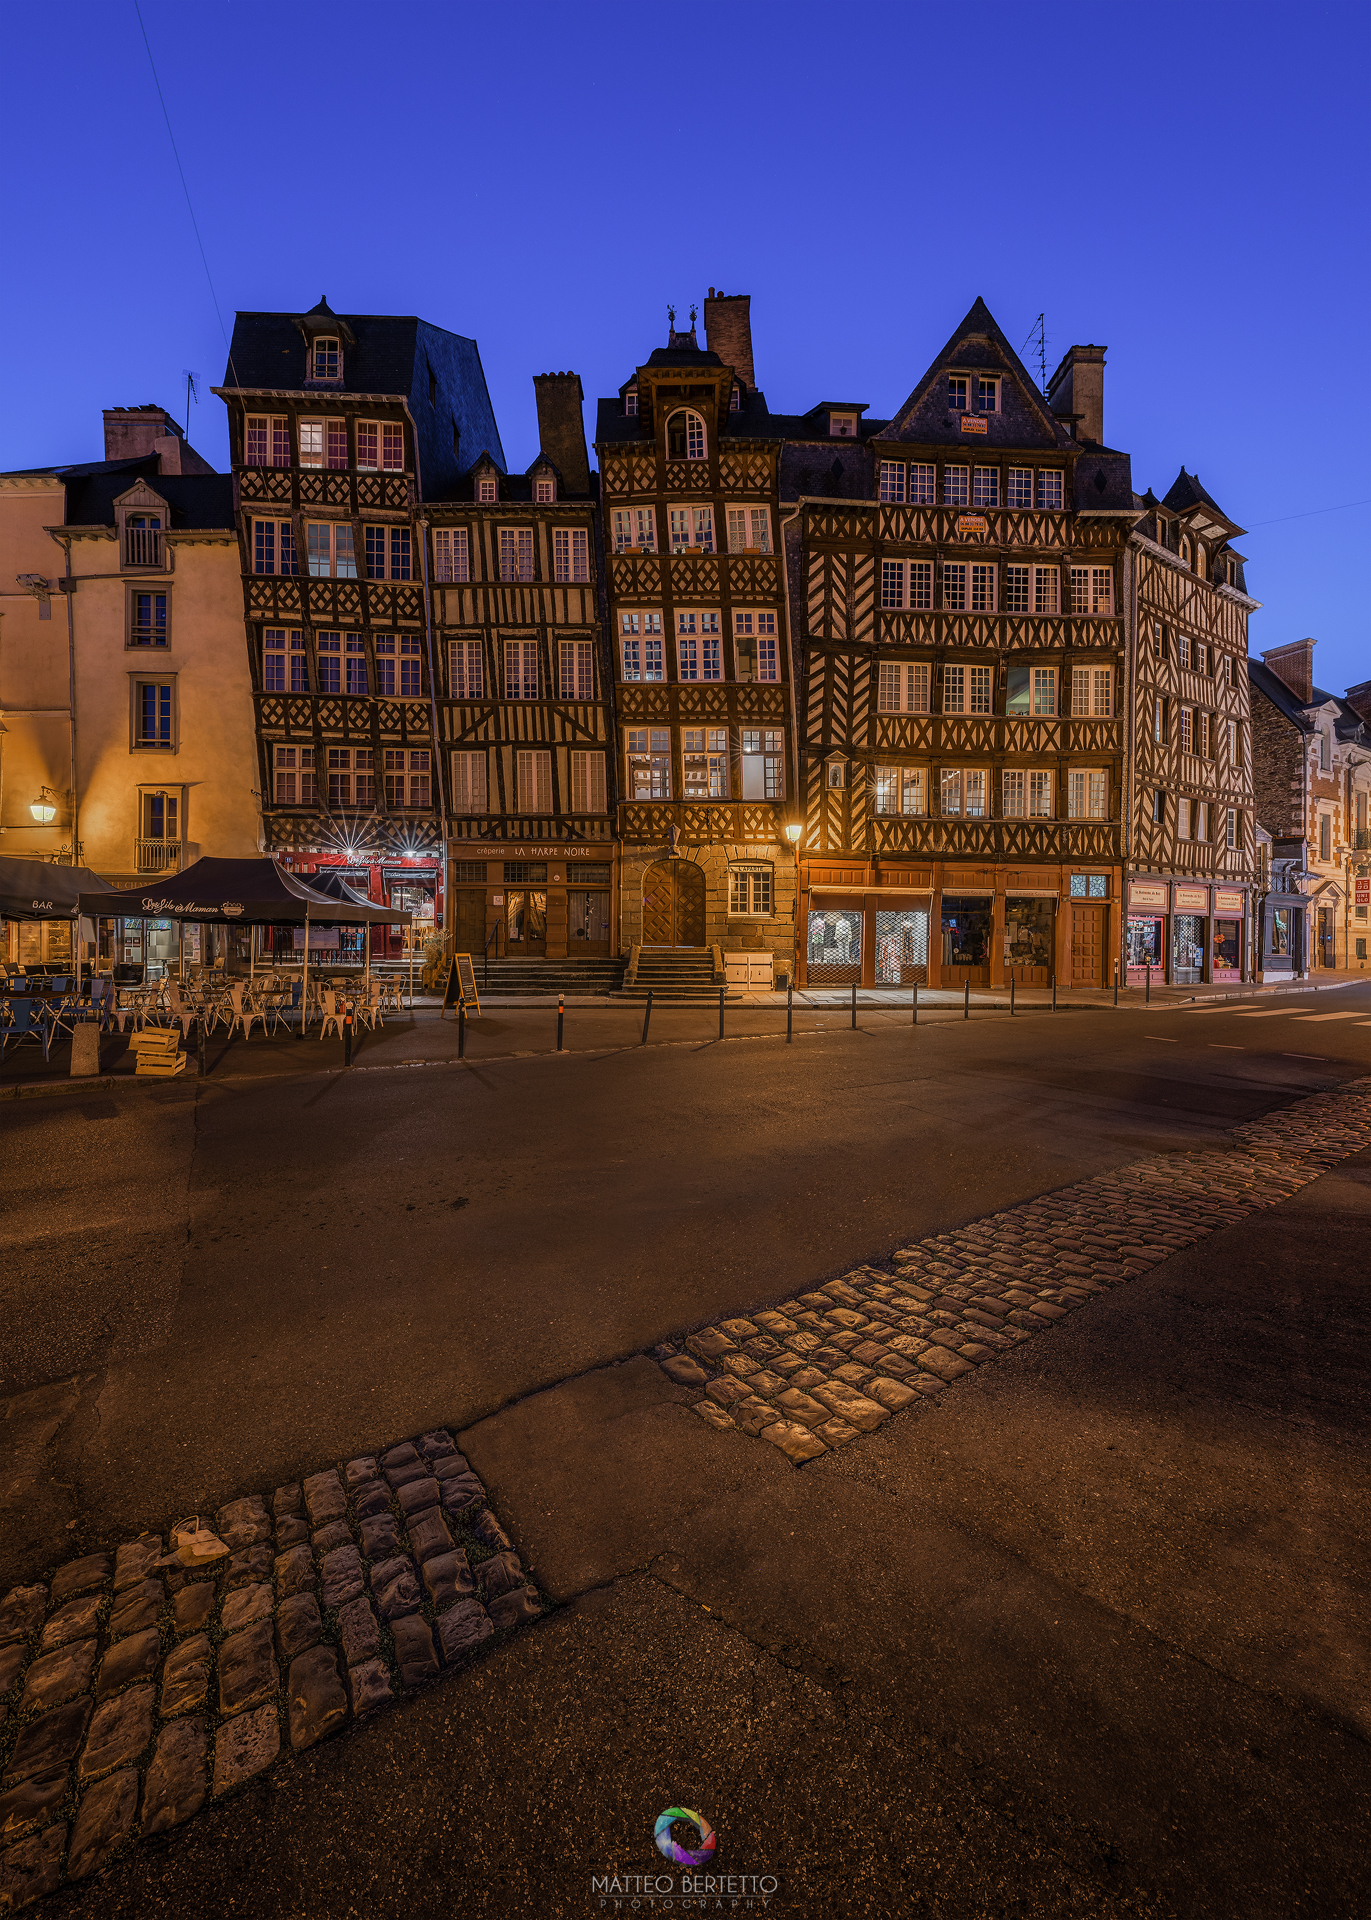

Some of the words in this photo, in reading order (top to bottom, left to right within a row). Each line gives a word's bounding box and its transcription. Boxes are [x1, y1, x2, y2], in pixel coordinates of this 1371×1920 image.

[477, 847, 505, 855] crêperie
[515, 847, 526, 856] LA
[531, 847, 558, 856] HARPE
[563, 847, 590, 856] NOIRE
[375, 856, 402, 865] Maman
[32, 900, 53, 909] BAR
[153, 898, 176, 914] fils
[181, 902, 219, 913] Maman
